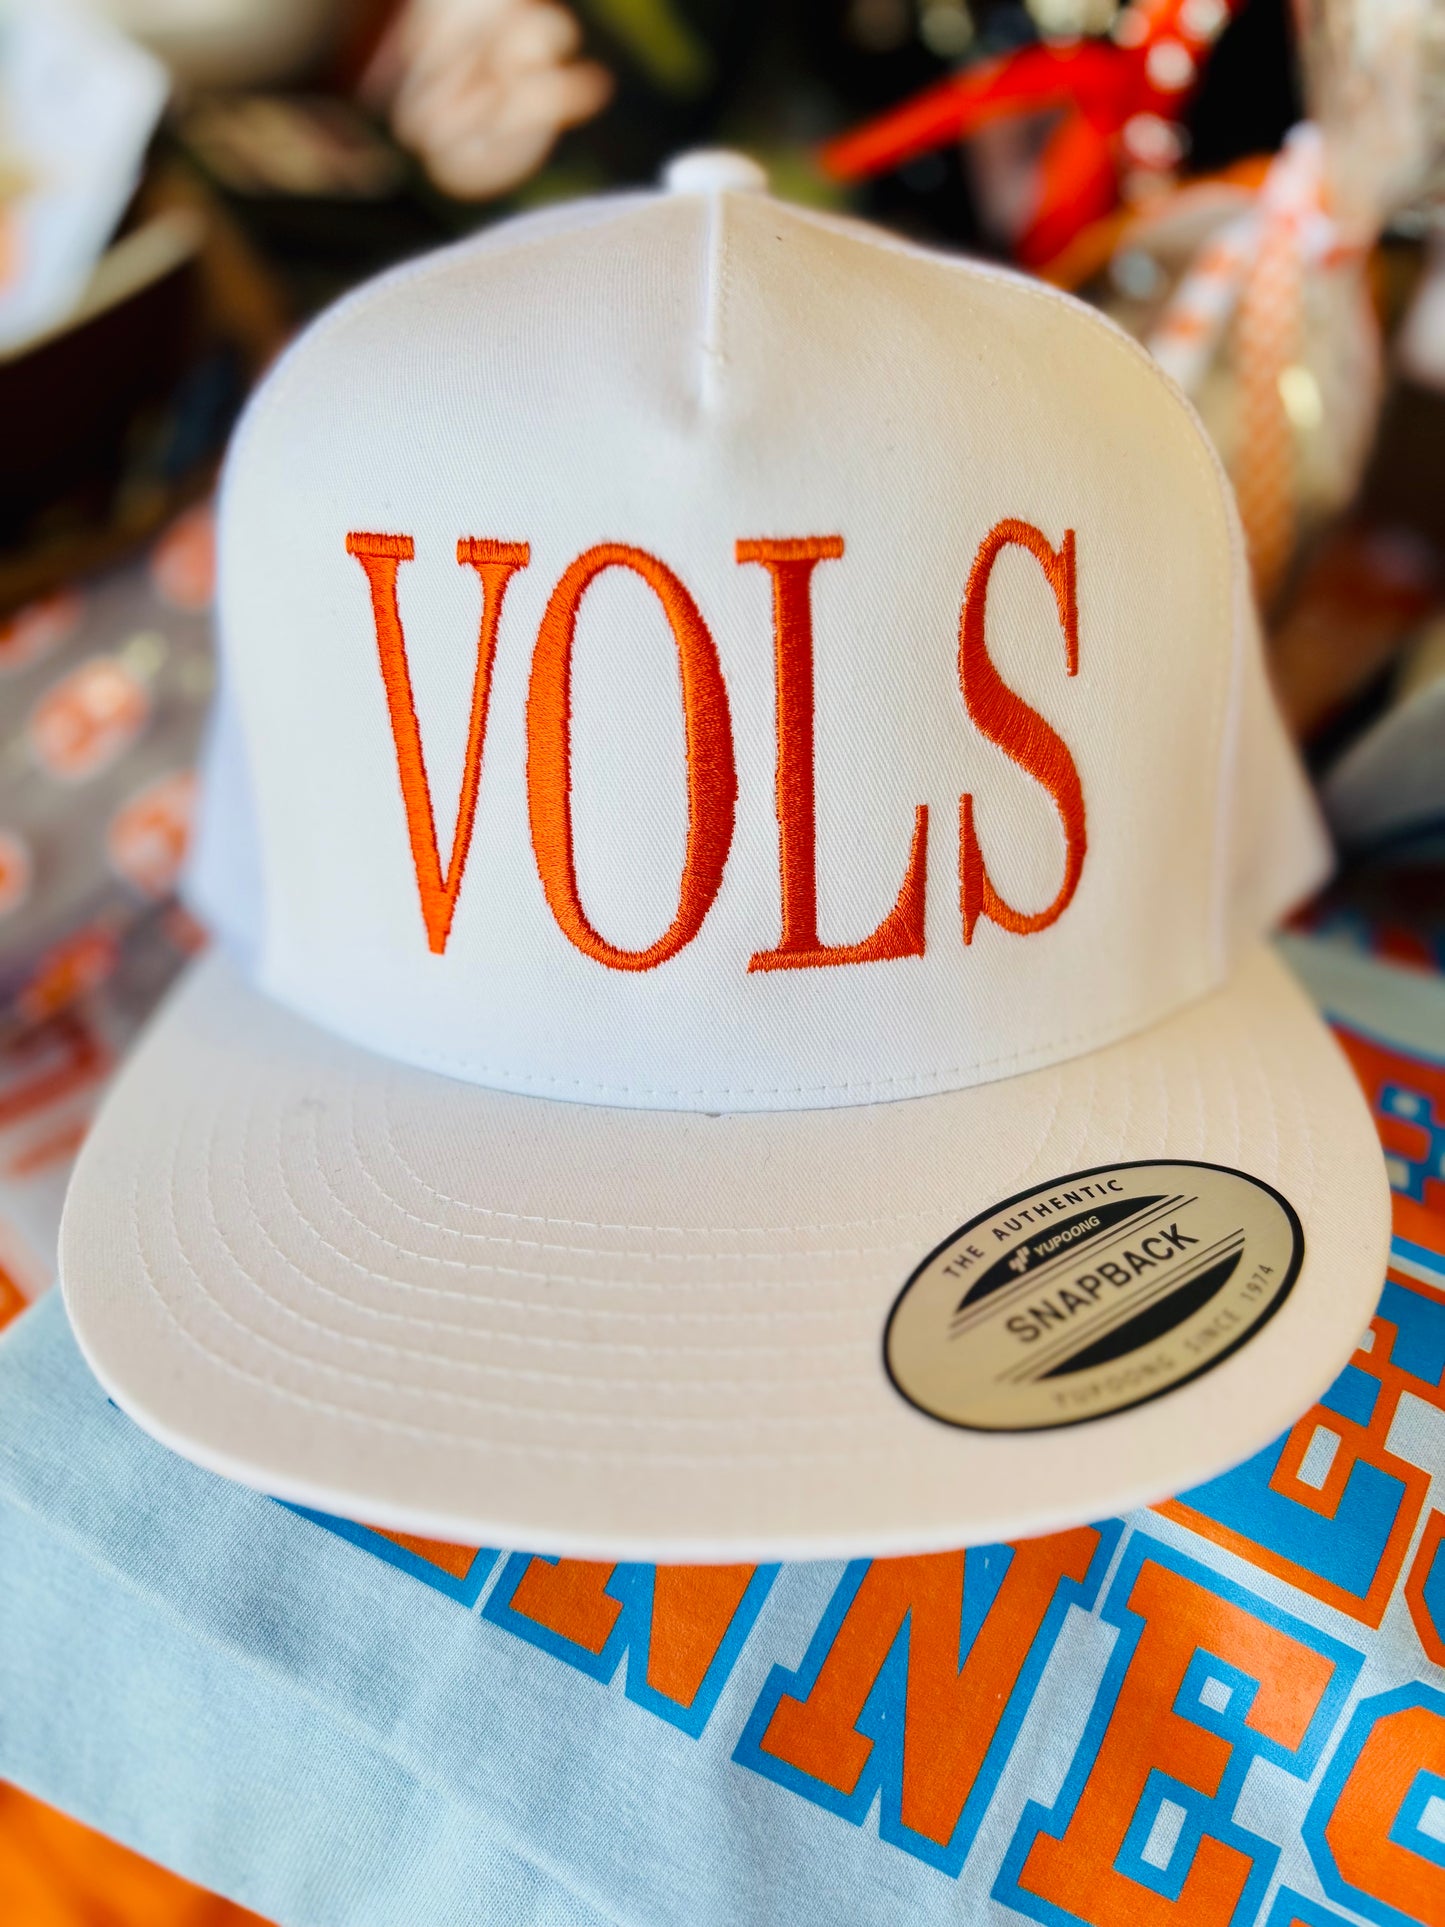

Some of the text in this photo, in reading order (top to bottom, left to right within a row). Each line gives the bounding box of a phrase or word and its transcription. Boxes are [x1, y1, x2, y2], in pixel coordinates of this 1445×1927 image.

[345, 518, 1088, 974] VOLS
[943, 1178, 1124, 1279] THE AUTHENTIC
[1034, 1215, 1101, 1257] YUPOONG
[1005, 1222, 1199, 1344] SNAPBACK
[1184, 1312, 1242, 1354] SINCE
[1240, 1262, 1275, 1303] 1974
